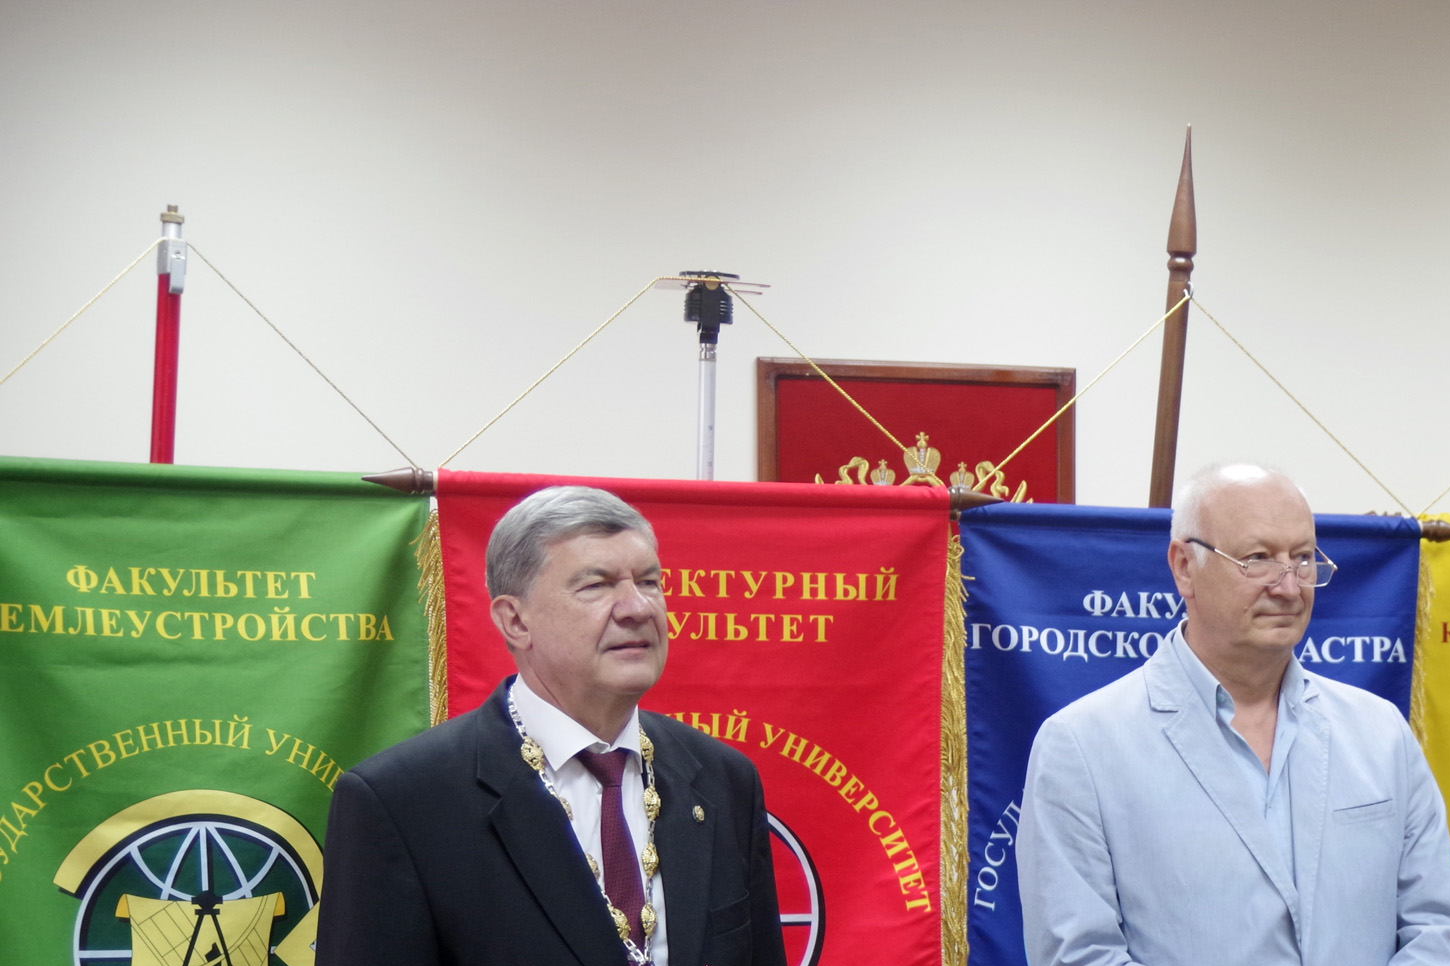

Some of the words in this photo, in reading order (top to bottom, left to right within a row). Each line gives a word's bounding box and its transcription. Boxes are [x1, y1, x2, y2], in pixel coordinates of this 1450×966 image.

[66, 564, 316, 599] ФАКУЛЬТЕТ
[1082, 589, 1188, 620] ФАКУ
[0, 603, 395, 642] ЕМЛЕУСТРОЙСТВА
[666, 611, 835, 643] УЛЬТЕТ
[1298, 635, 1408, 664] АСТРА
[0, 713, 253, 880] ДАРСТВЕННЫЙ
[760, 722, 932, 913] УНИВЕРСИТЕТ
